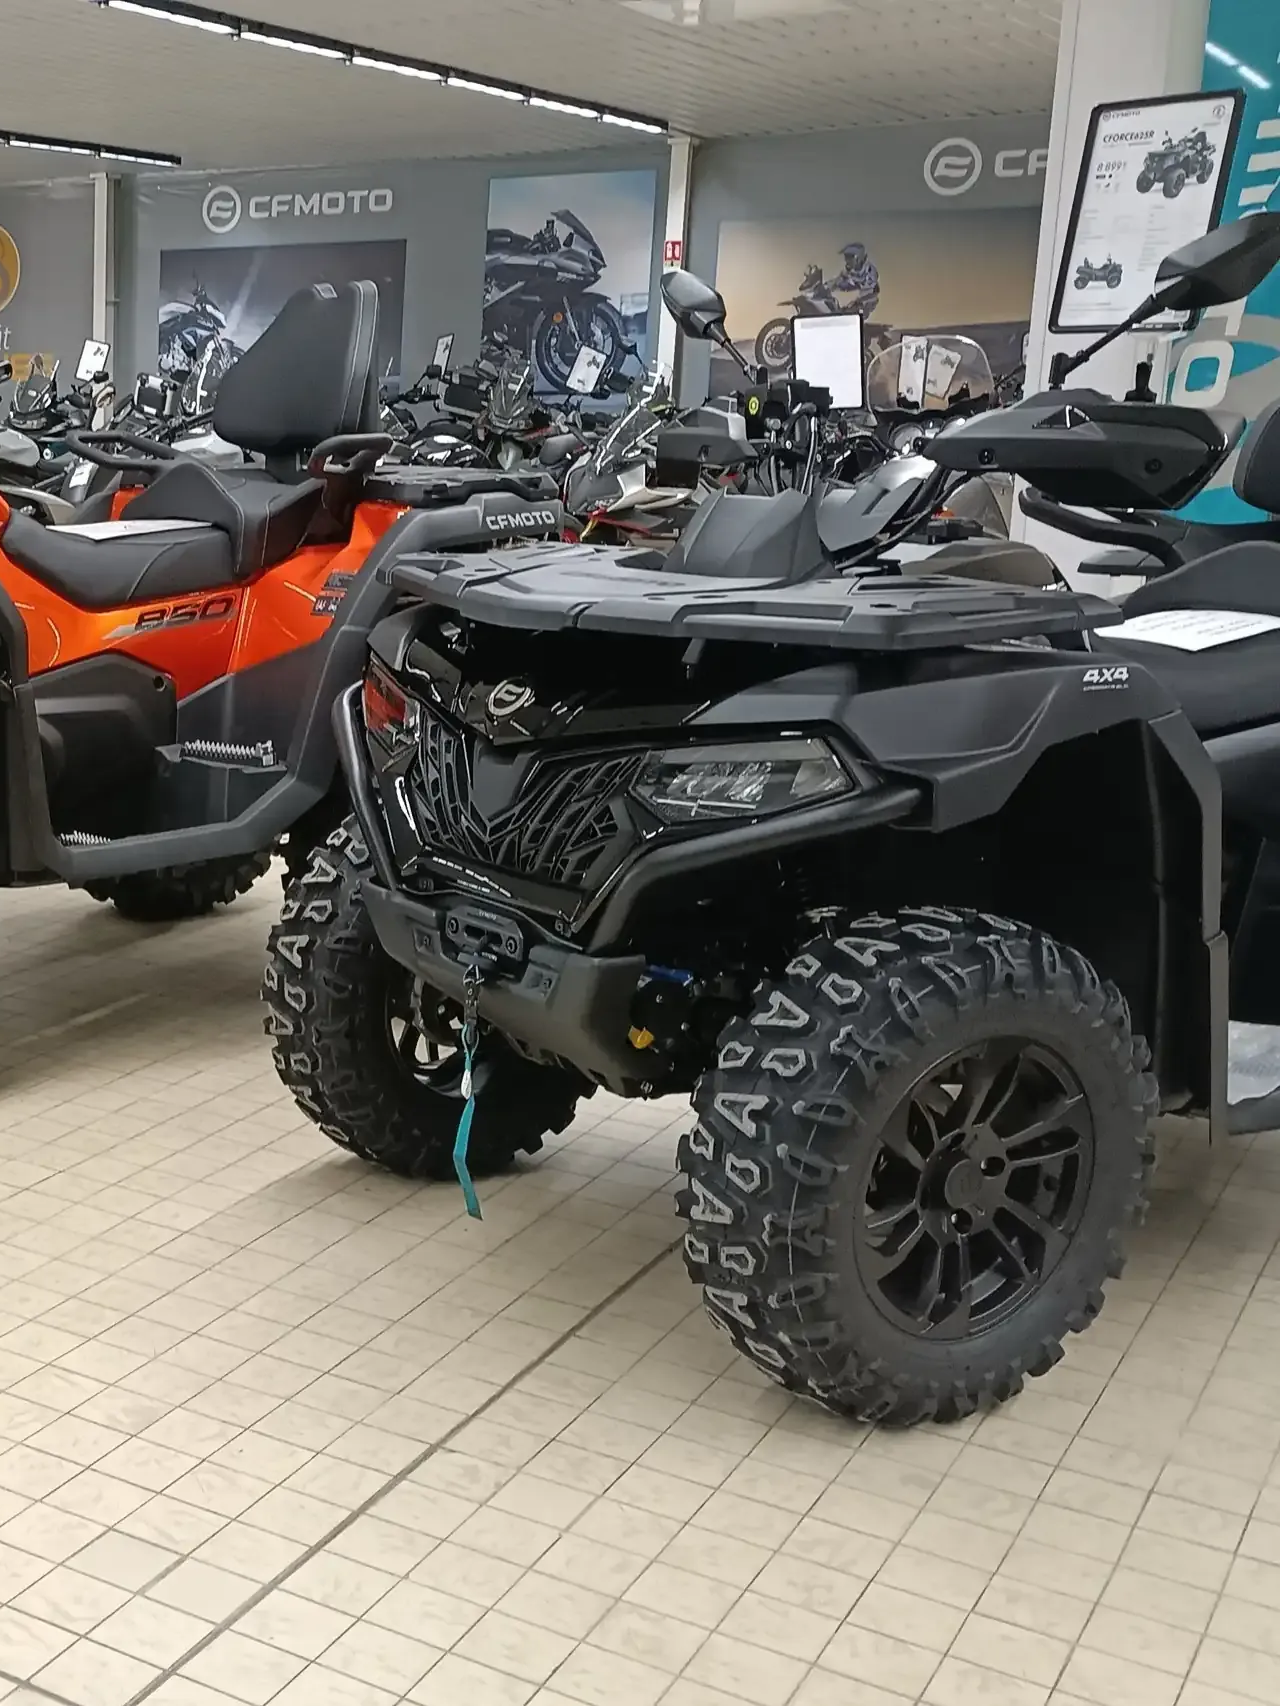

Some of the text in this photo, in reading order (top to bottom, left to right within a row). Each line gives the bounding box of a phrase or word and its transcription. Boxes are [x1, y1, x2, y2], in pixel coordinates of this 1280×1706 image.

[1103, 130, 1155, 143] CFORCE625R
[248, 188, 393, 218] CFMOTO
[485, 510, 556, 530] CFMOTO
[134, 594, 237, 631] 850
